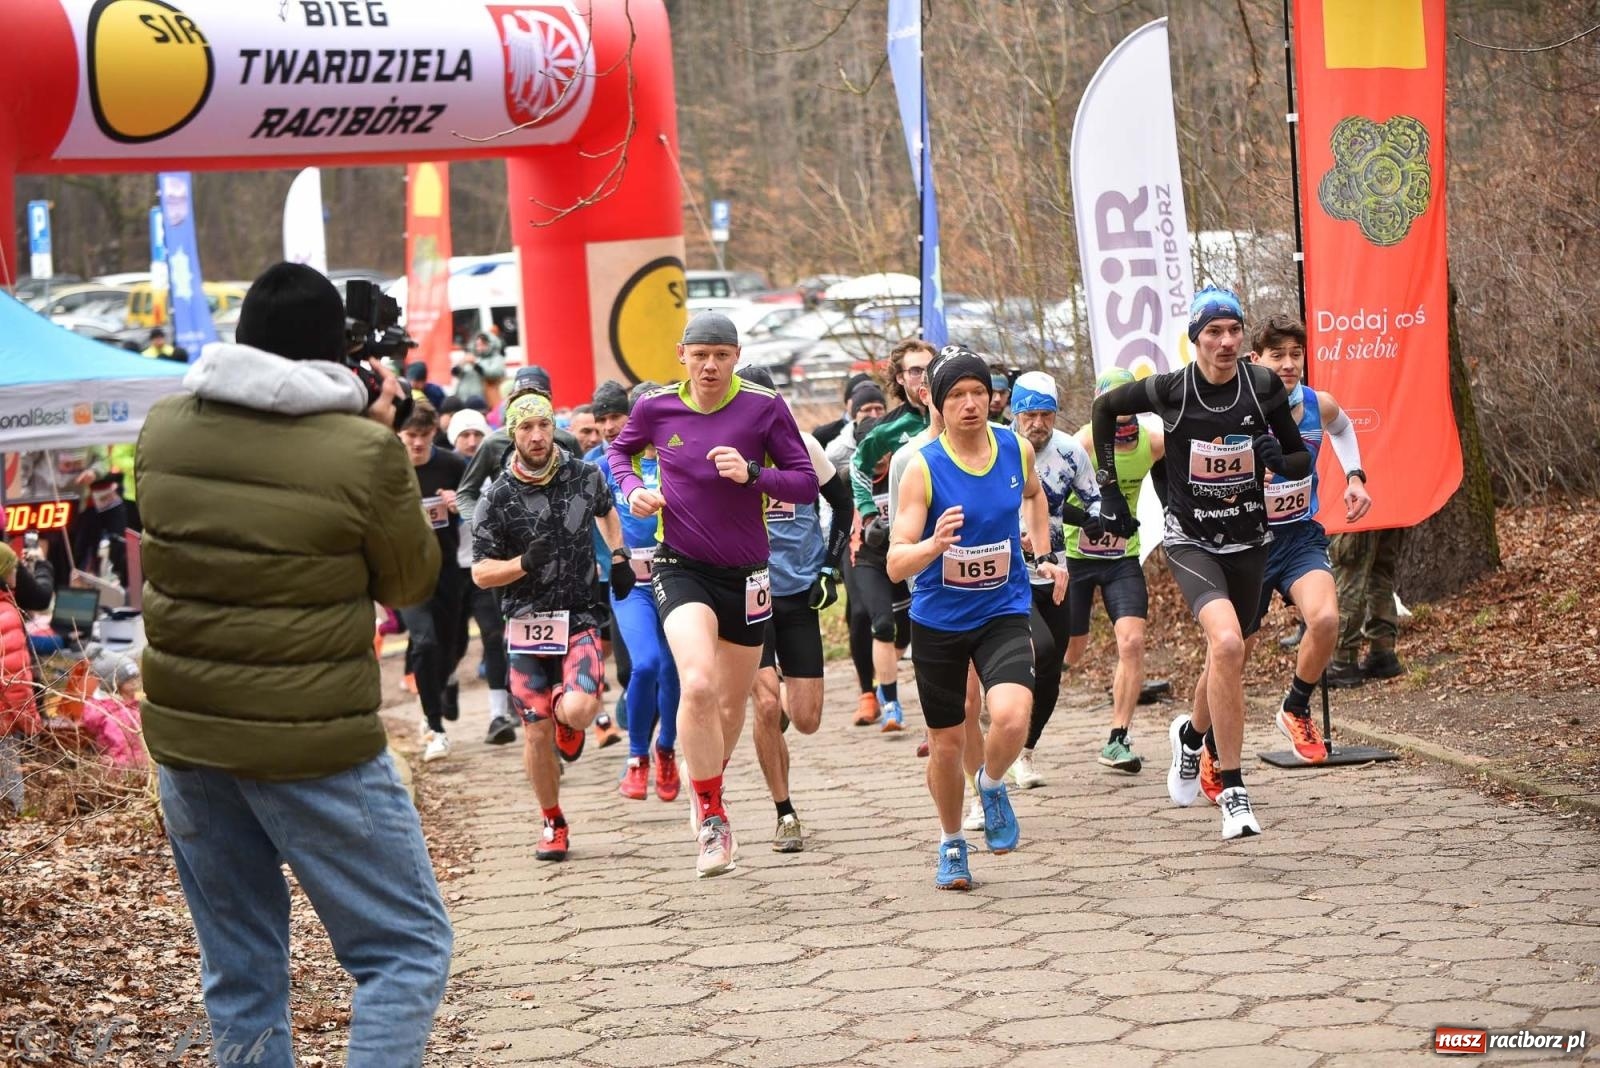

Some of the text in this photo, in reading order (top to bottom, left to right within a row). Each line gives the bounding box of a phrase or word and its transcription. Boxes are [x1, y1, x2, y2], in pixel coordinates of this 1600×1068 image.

[302, 1, 389, 27] BIEG
[138, 14, 207, 44] SIR
[239, 49, 474, 84] TWARDZIELA
[249, 96, 447, 139] RACIBÓRZ
[1155, 184, 1188, 317] RACIBÓRZ
[1317, 308, 1388, 335] Dodaj
[1317, 336, 1399, 361] od siebie
[0, 408, 67, 429] onalBest
[1204, 457, 1242, 473] 184
[1193, 505, 1240, 522] RUNNERS
[1274, 493, 1305, 512] 226
[958, 560, 997, 578] 165
[524, 624, 555, 641] 132
